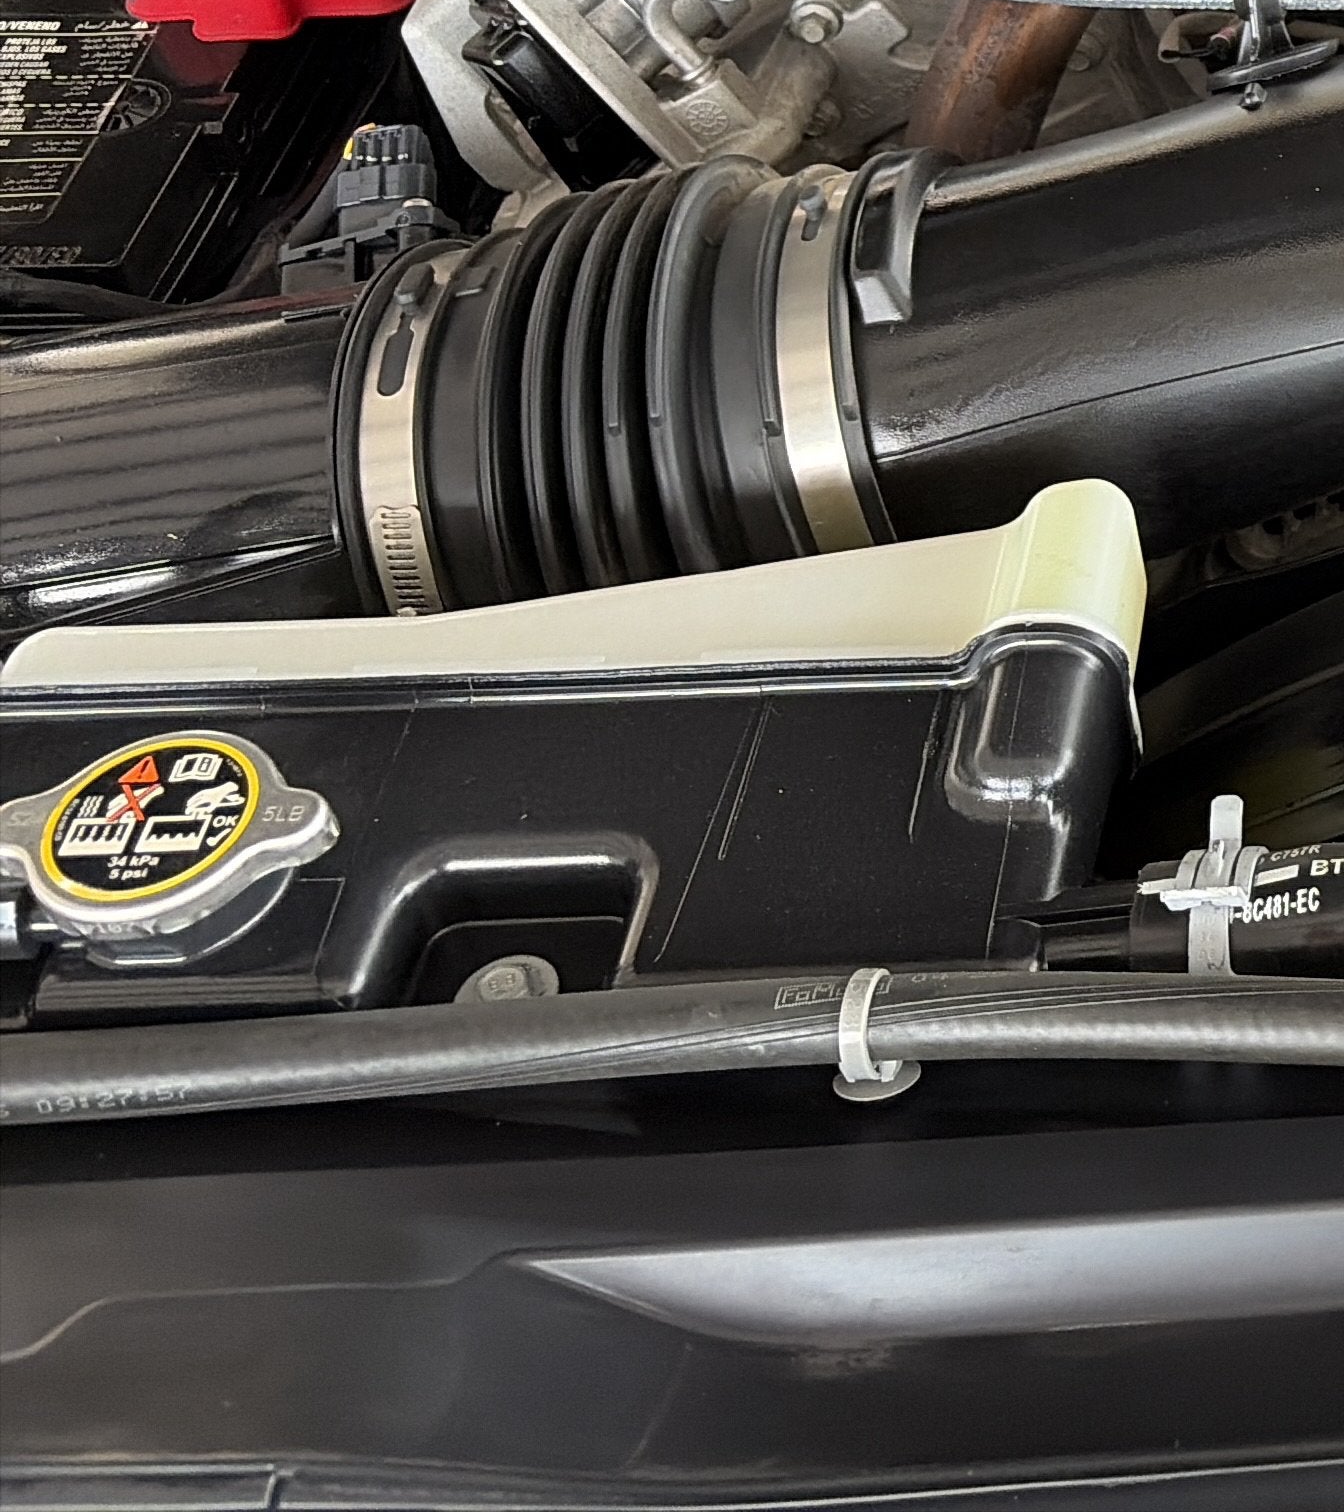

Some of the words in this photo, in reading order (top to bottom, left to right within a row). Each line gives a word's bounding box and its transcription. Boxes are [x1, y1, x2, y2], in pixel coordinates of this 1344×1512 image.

[211, 814, 239, 828] OK
[107, 855, 127, 868] 34
[128, 854, 160, 868] kPa
[108, 868, 120, 880] 5
[121, 868, 149, 882] psi
[1229, 886, 1321, 925] -8C481-EC
